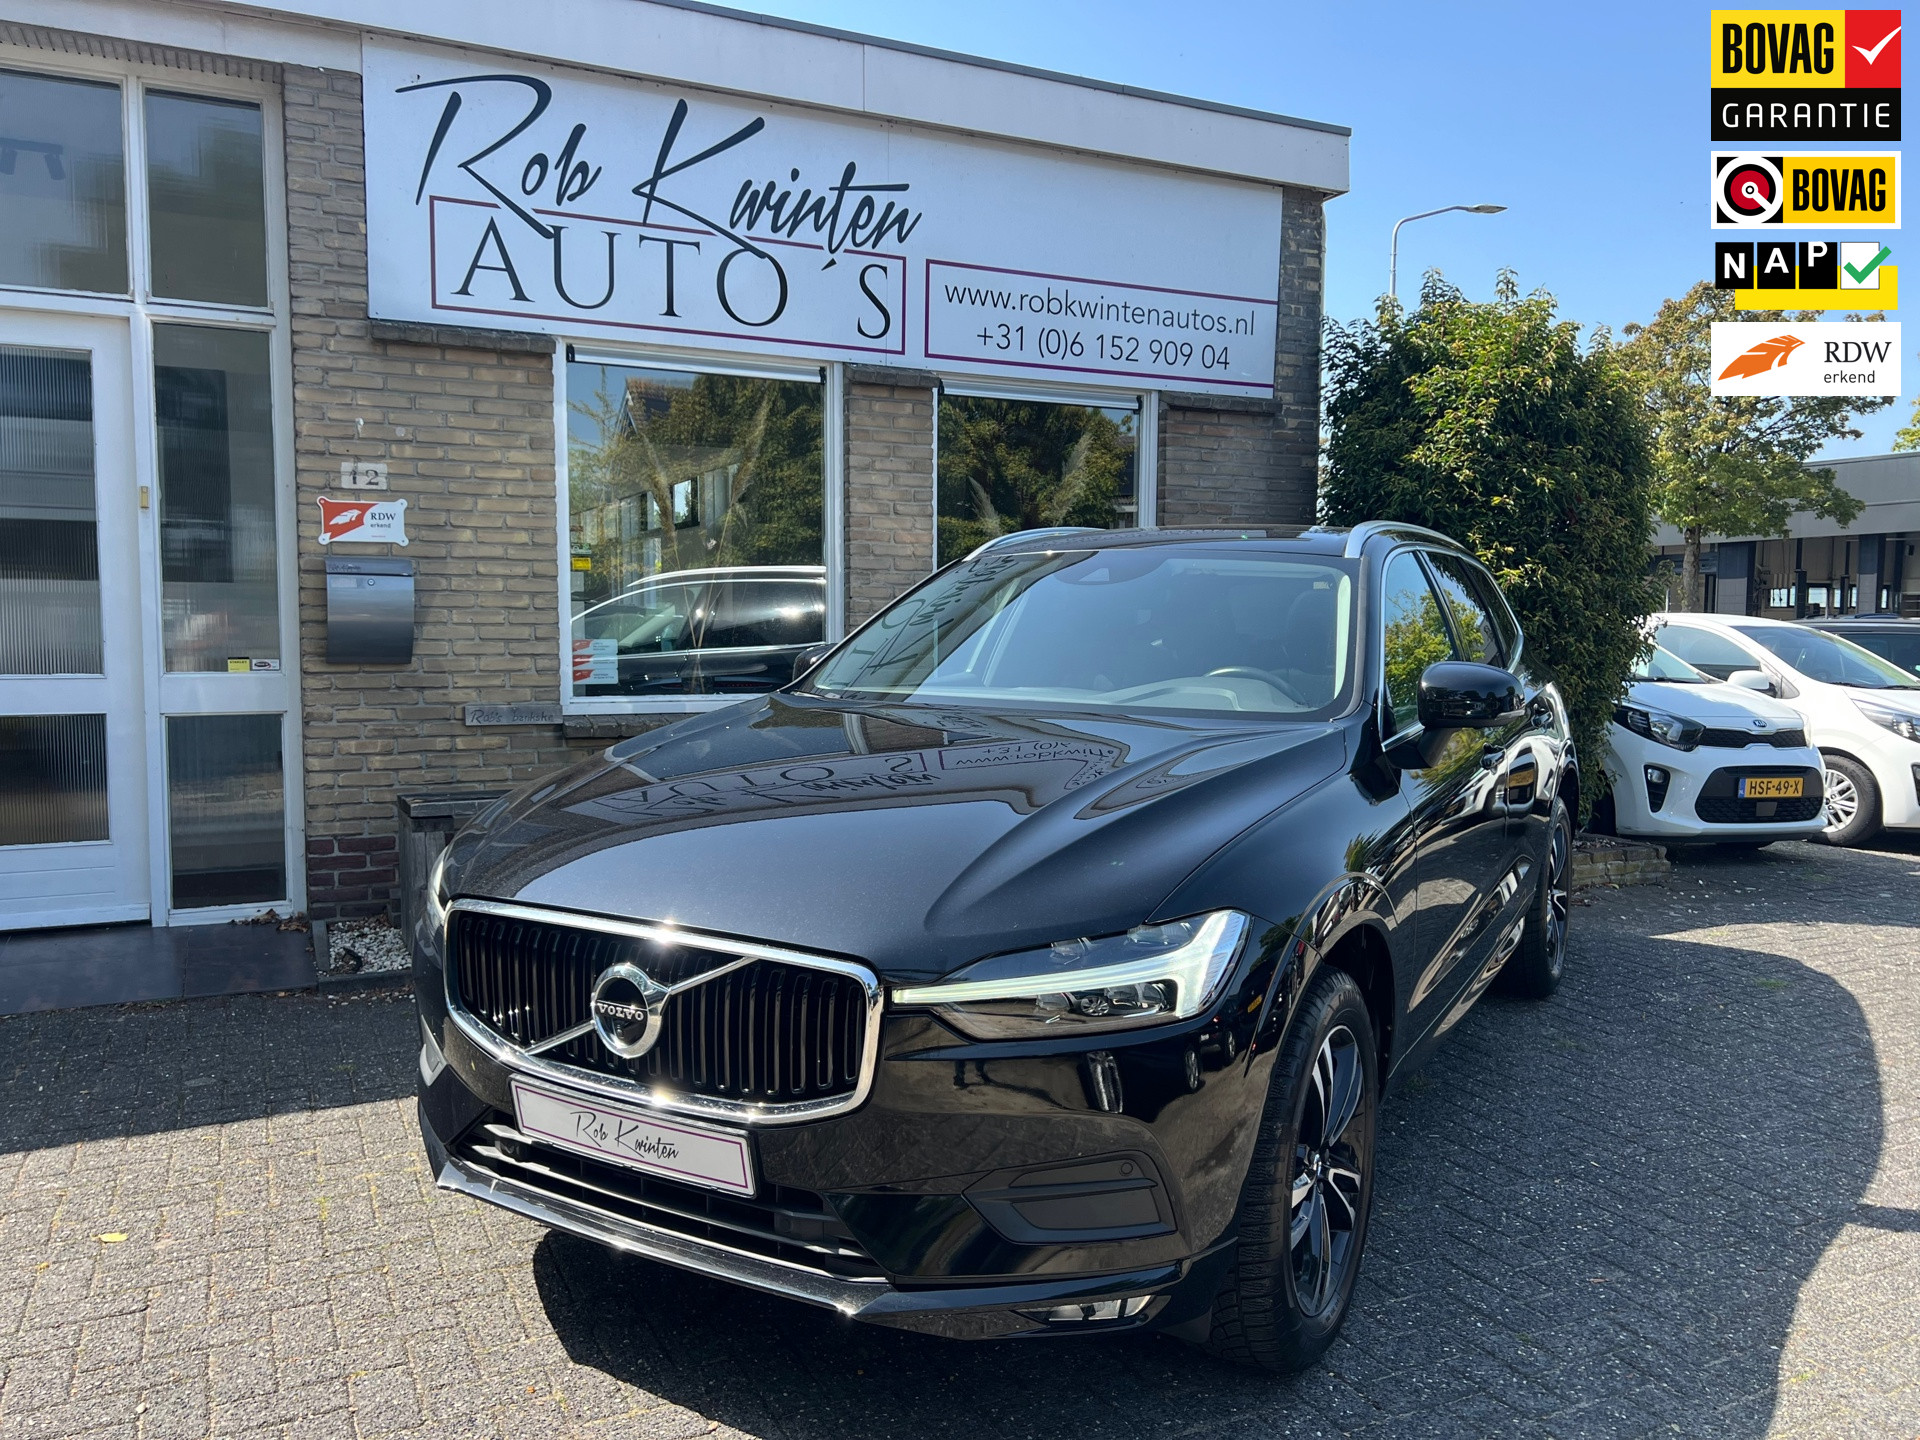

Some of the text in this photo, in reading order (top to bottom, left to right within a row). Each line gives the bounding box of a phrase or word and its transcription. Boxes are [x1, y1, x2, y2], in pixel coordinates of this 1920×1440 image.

[395, 73, 923, 259] Rob Kwinten
[945, 284, 1255, 336] www.robkwintenautos.nl
[976, 323, 1230, 371] +31 (0)6 152 909 04
[370, 512, 396, 521] RDW
[1749, 780, 1800, 795] HSF-49-X
[598, 1003, 645, 1021] VOLVO
[570, 1111, 680, 1160] Rob Kwinten
